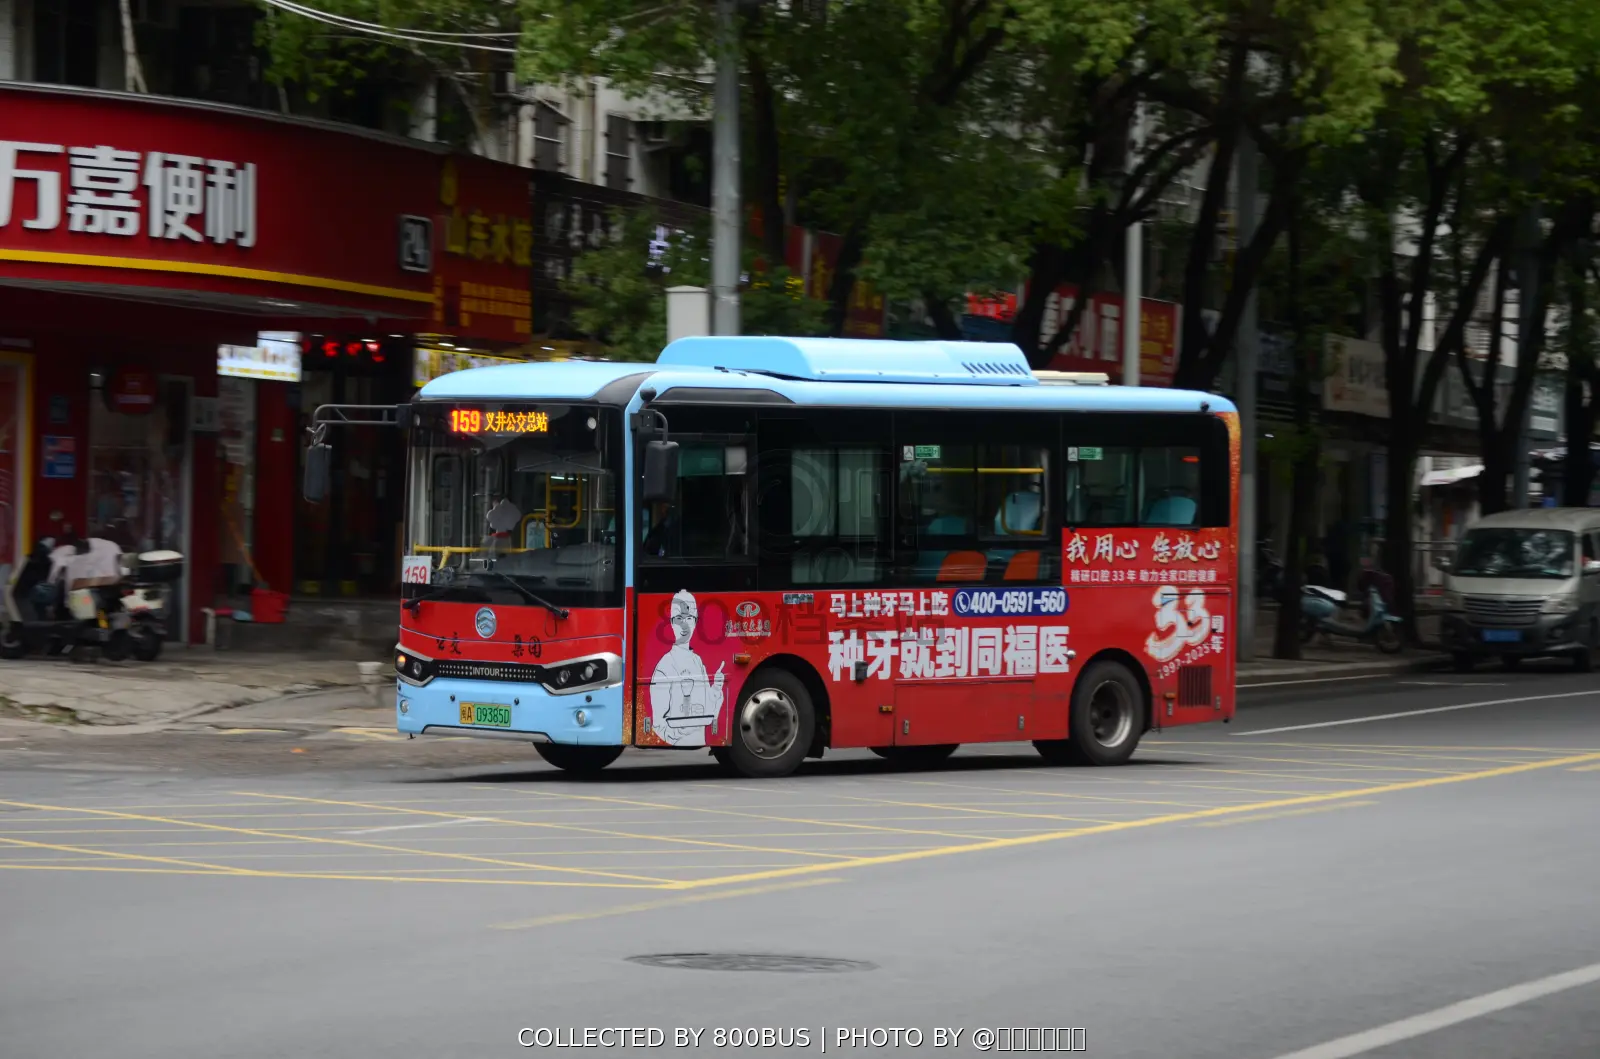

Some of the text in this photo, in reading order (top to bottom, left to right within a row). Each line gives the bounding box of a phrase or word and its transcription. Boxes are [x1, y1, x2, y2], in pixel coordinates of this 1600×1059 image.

[0, 140, 257, 248] 万嘉便利
[451, 410, 480, 432] 159
[1066, 531, 1221, 564] 我用心 您放心
[404, 565, 427, 585] 159
[829, 591, 949, 619] 马上种牙马上吃
[970, 590, 1066, 615] 400-0591-560
[828, 625, 1070, 682] 种牙就到同福医
[472, 666, 500, 678] INTOUR
